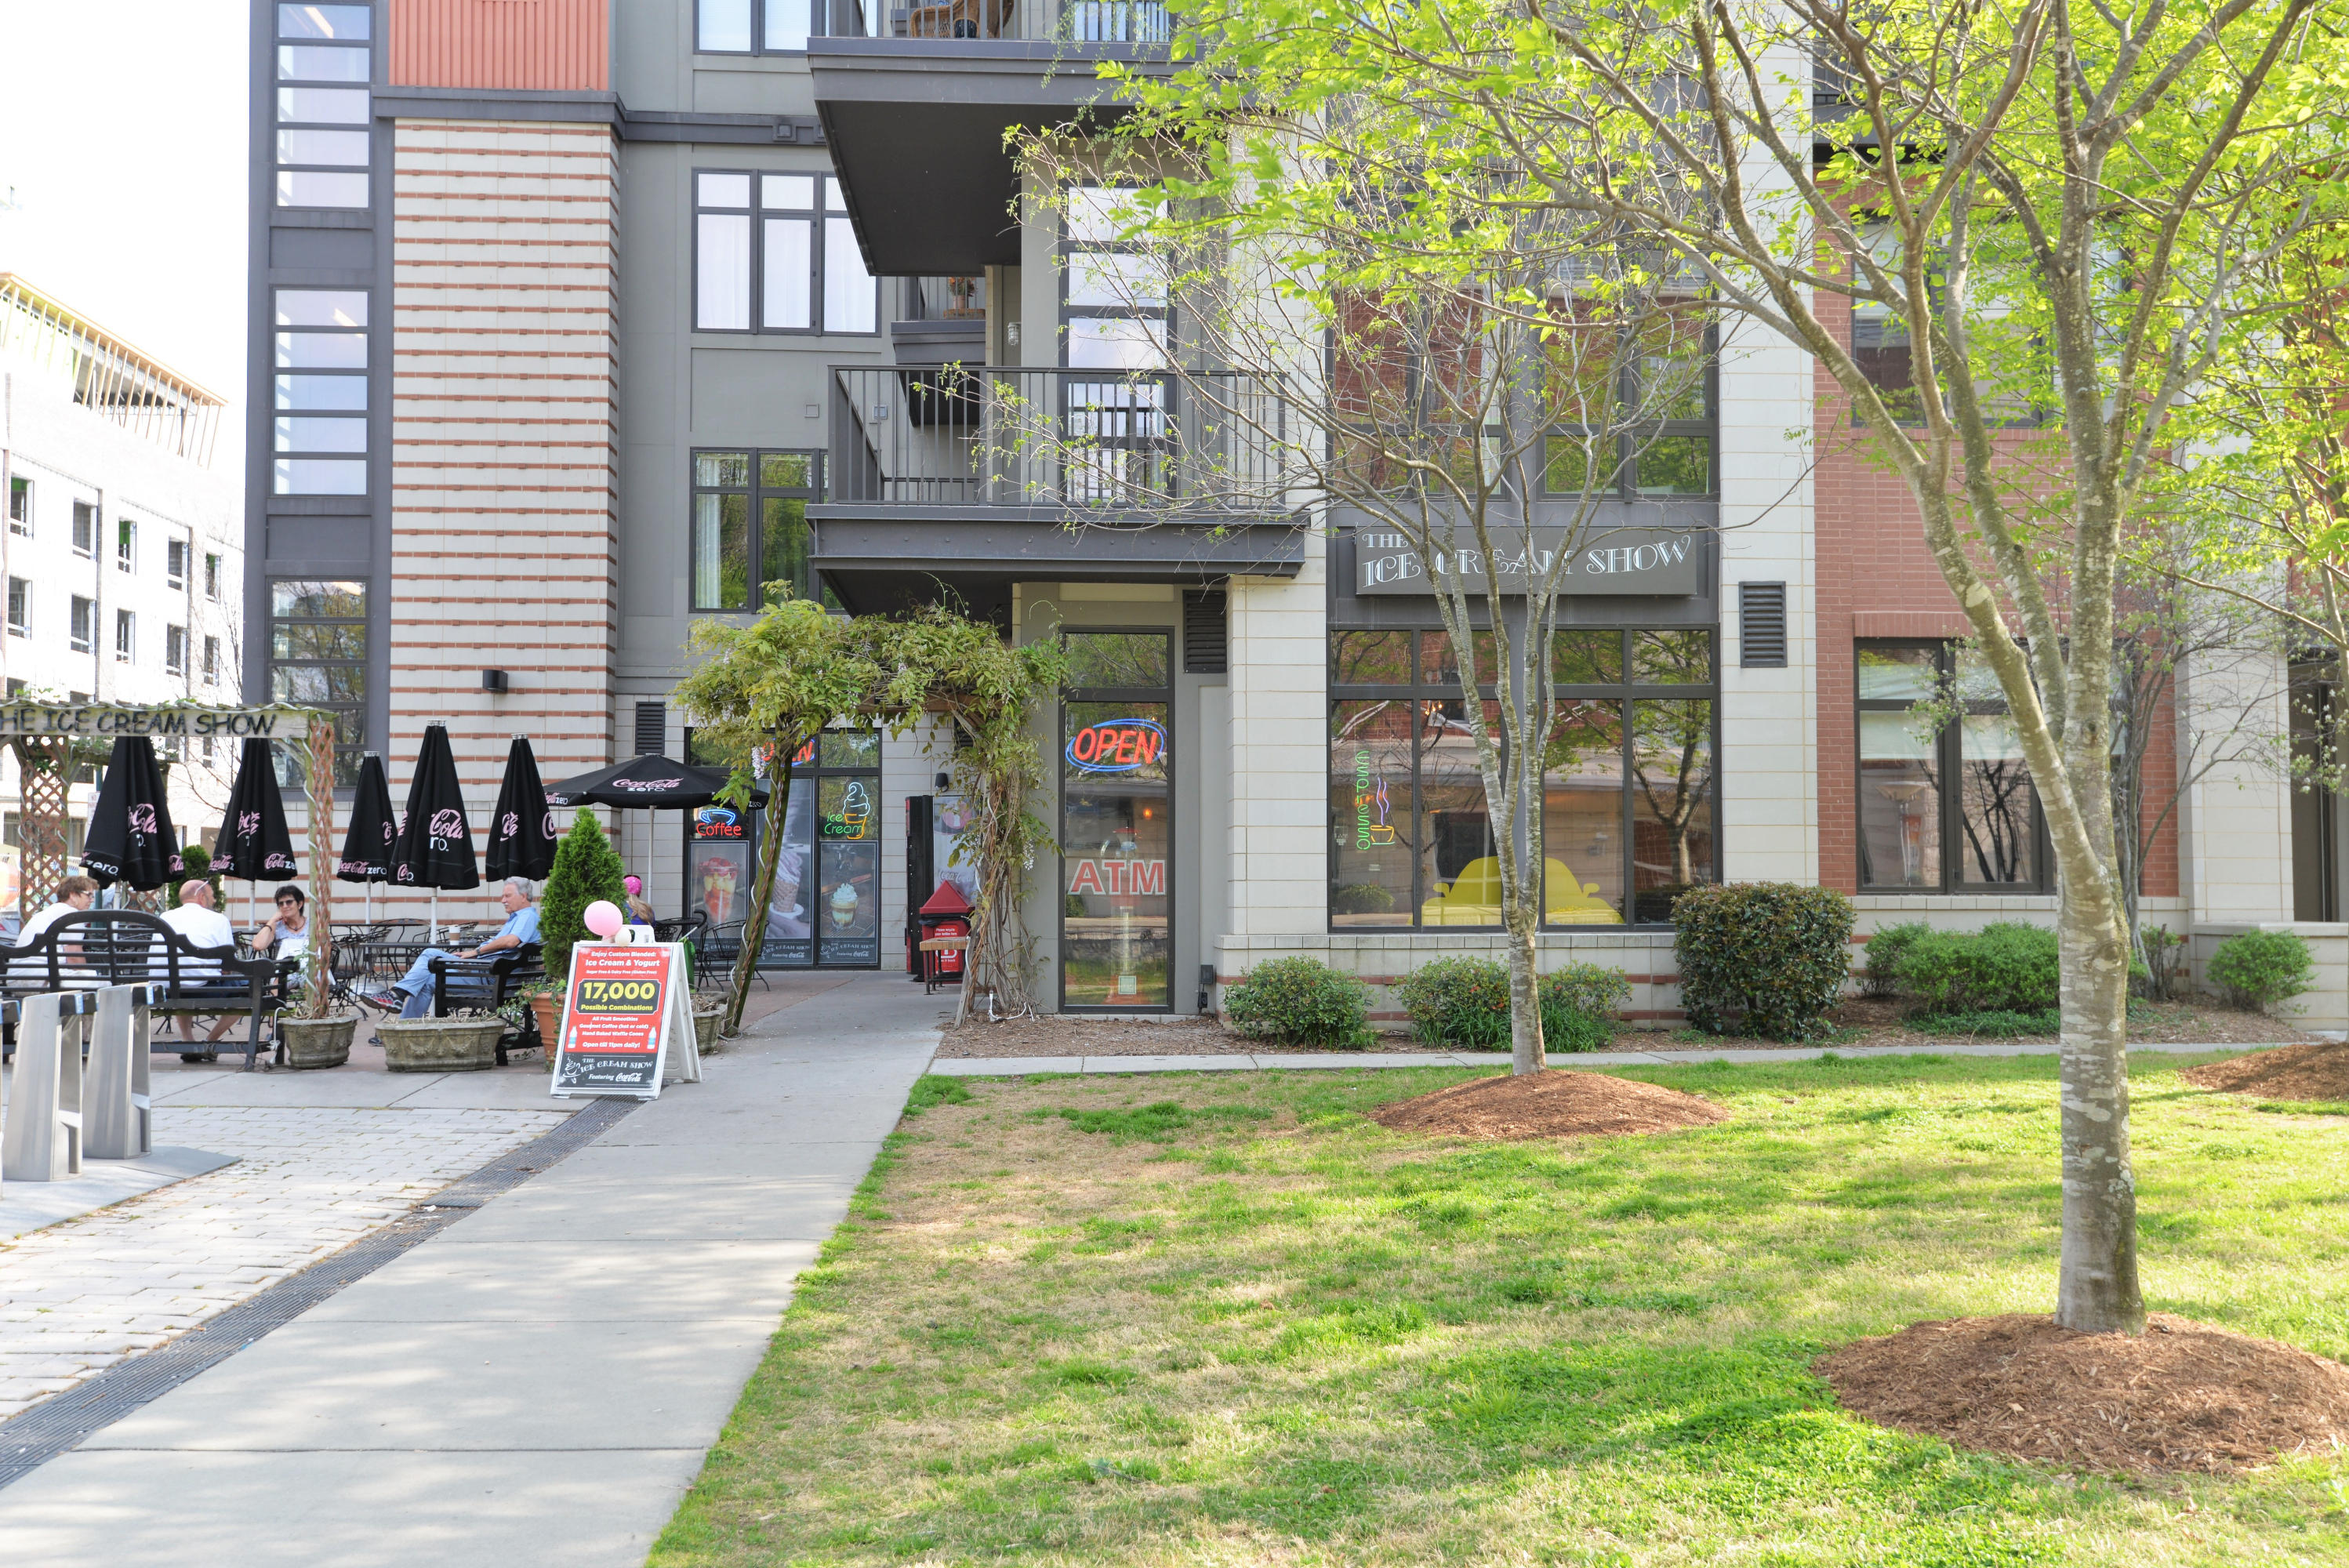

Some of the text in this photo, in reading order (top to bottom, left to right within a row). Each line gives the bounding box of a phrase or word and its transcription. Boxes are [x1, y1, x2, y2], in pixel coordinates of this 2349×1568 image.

[1362, 533, 1409, 548] THE
[1362, 552, 1421, 588] ICE
[1586, 535, 1691, 575] SHOW
[42, 709, 90, 733] ICE
[97, 711, 187, 735] CREAM
[194, 713, 277, 736] SHOW
[761, 741, 814, 762] ON
[1074, 728, 1158, 764] OPEN
[826, 811, 843, 822] Ice
[696, 822, 742, 837] Coffee
[824, 823, 863, 835] Cream
[1067, 859, 1166, 895] ATM
[634, 959, 660, 967] Yogurt
[583, 982, 655, 1002] 17,000
[580, 1063, 595, 1073] ICE
